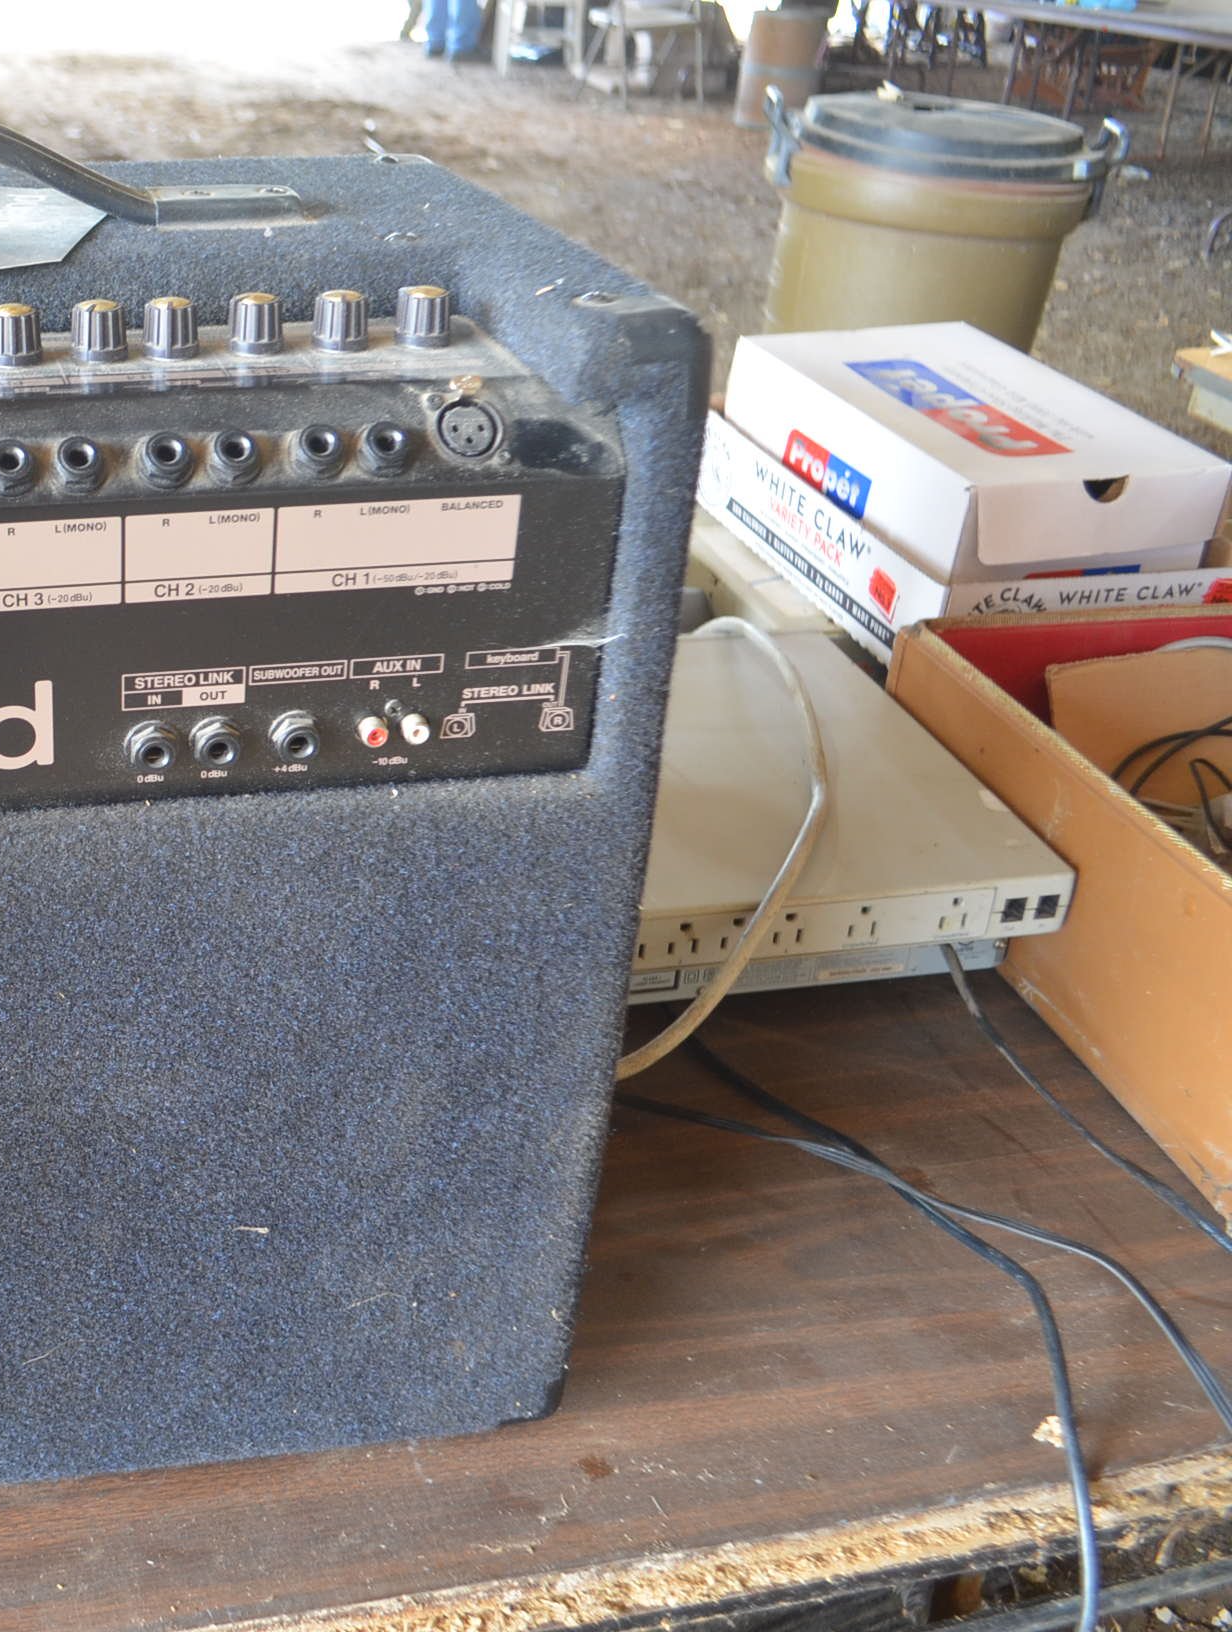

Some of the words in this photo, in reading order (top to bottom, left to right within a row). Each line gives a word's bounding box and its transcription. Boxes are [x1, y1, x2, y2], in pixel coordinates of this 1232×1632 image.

[790, 439, 861, 507] Propét
[441, 500, 504, 512] BALANCED
[755, 461, 807, 517] WHITE
[814, 509, 865, 560] CLAW
[314, 510, 322, 518] R
[162, 518, 170, 527] R
[8, 527, 16, 536] R
[331, 573, 359, 587] CH
[362, 572, 370, 585] 1
[154, 584, 180, 598] CH
[185, 582, 195, 596] 2
[1059, 587, 1128, 606] WHITE
[1136, 582, 1196, 601] CLAW
[2, 594, 27, 608] CH
[34, 592, 44, 606] 3
[486, 652, 539, 664] keyboard
[254, 667, 319, 680] SUBWOOFER
[321, 665, 344, 676] OUT
[373, 660, 404, 674] AUX
[406, 658, 421, 671] IN
[134, 673, 196, 690] STEREO
[200, 671, 234, 685] LINK
[370, 680, 379, 690] R
[413, 677, 421, 687] L
[200, 691, 227, 701] OUT
[462, 685, 518, 699] STEREO
[522, 682, 555, 695] LINK
[148, 695, 162, 705] IN
